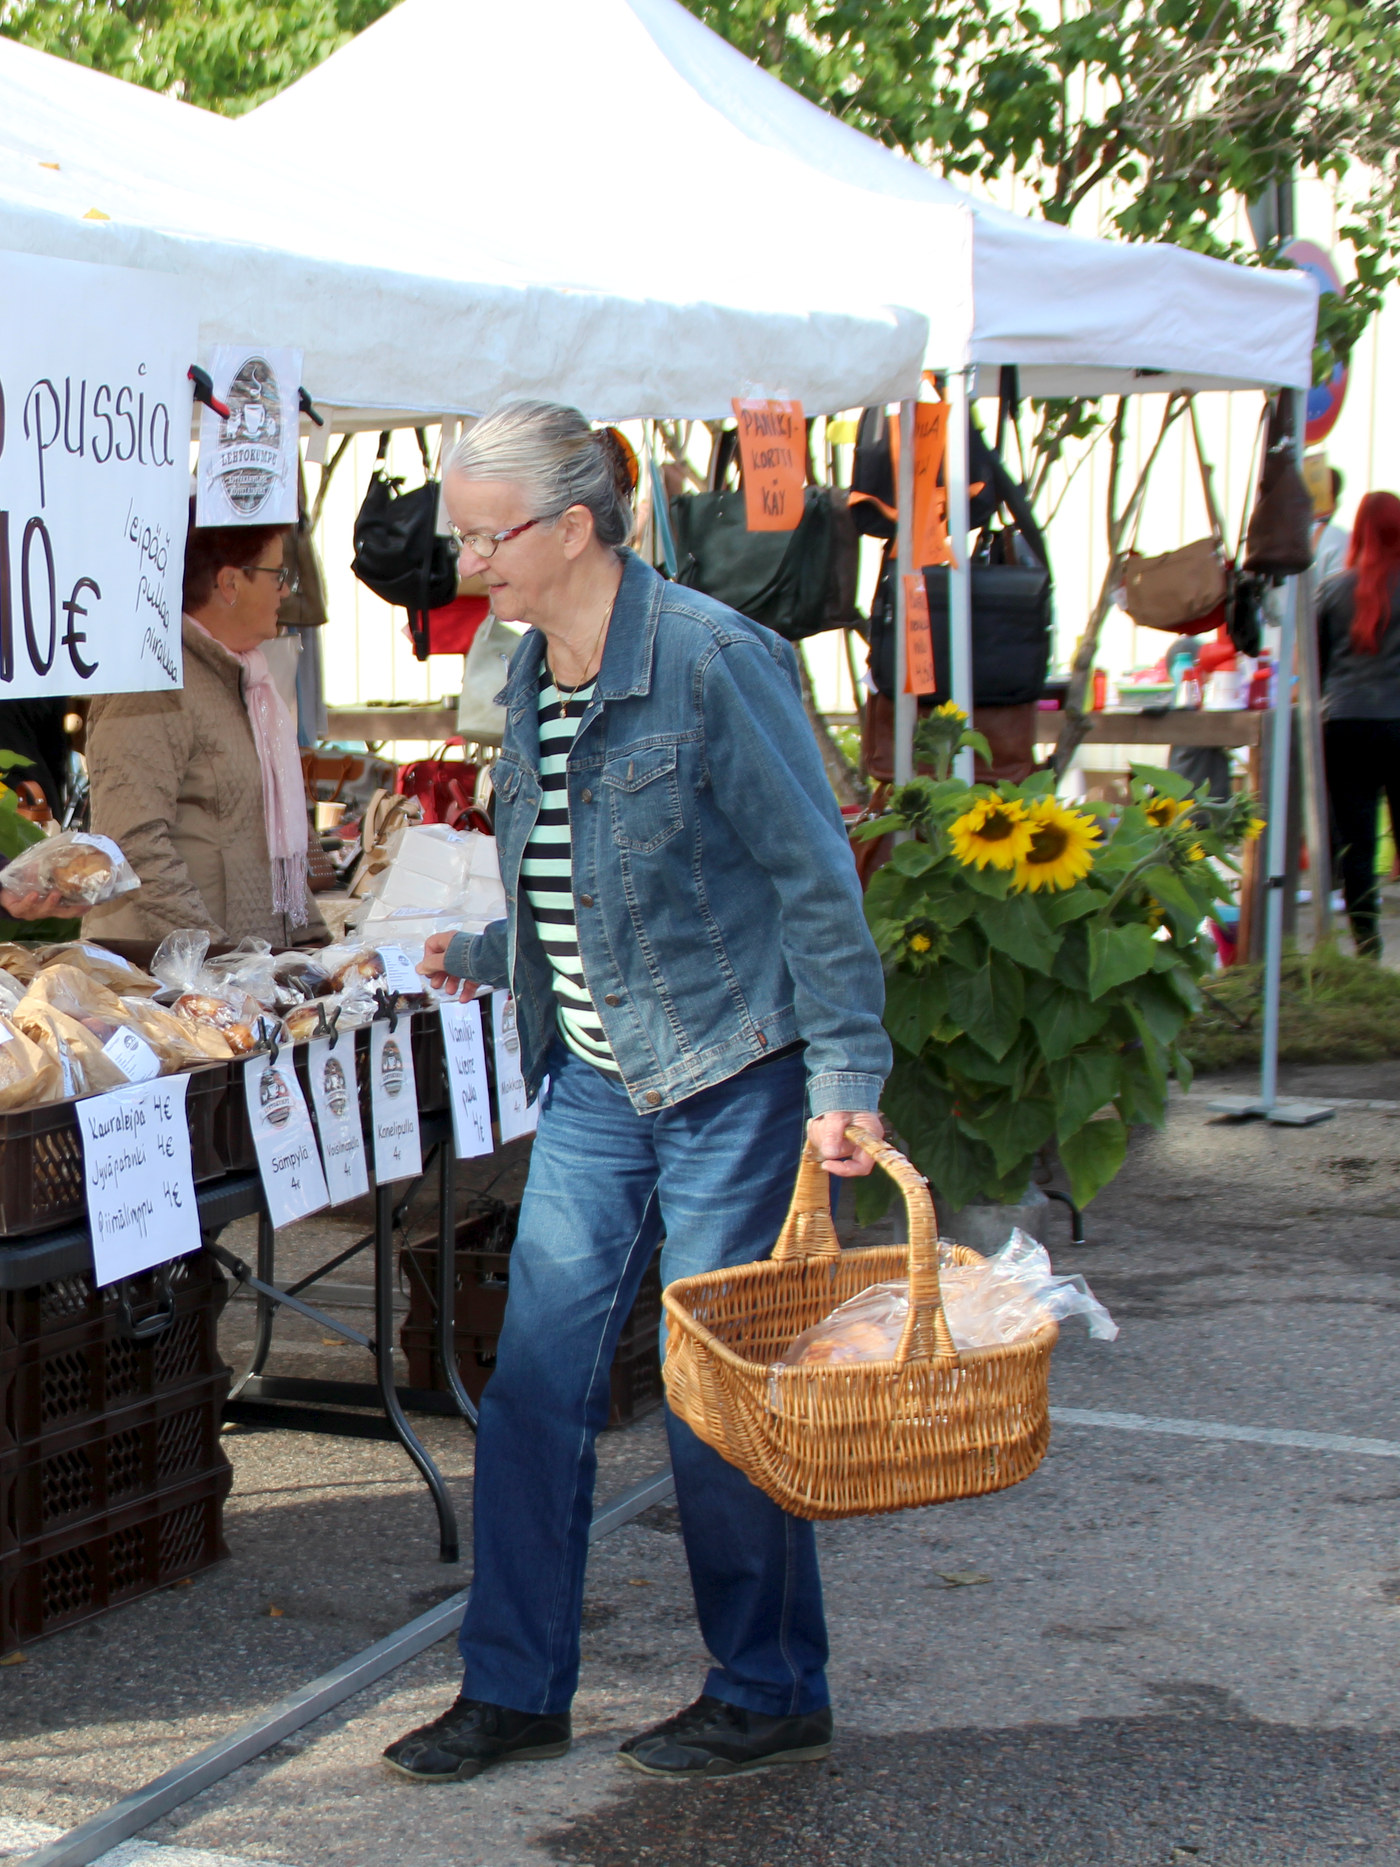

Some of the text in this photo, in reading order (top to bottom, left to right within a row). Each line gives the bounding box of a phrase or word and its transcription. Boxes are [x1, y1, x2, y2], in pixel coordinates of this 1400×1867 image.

[24, 363, 174, 508] pussia
[221, 449, 278, 467] LEHTOKUMPU
[752, 448, 793, 470] KORTTI
[89, 1095, 173, 1140] Kauraleipä 4€
[378, 1119, 414, 1140] Kanelipulla
[157, 1134, 175, 1157] 4€
[271, 1145, 309, 1174] Sämpylä
